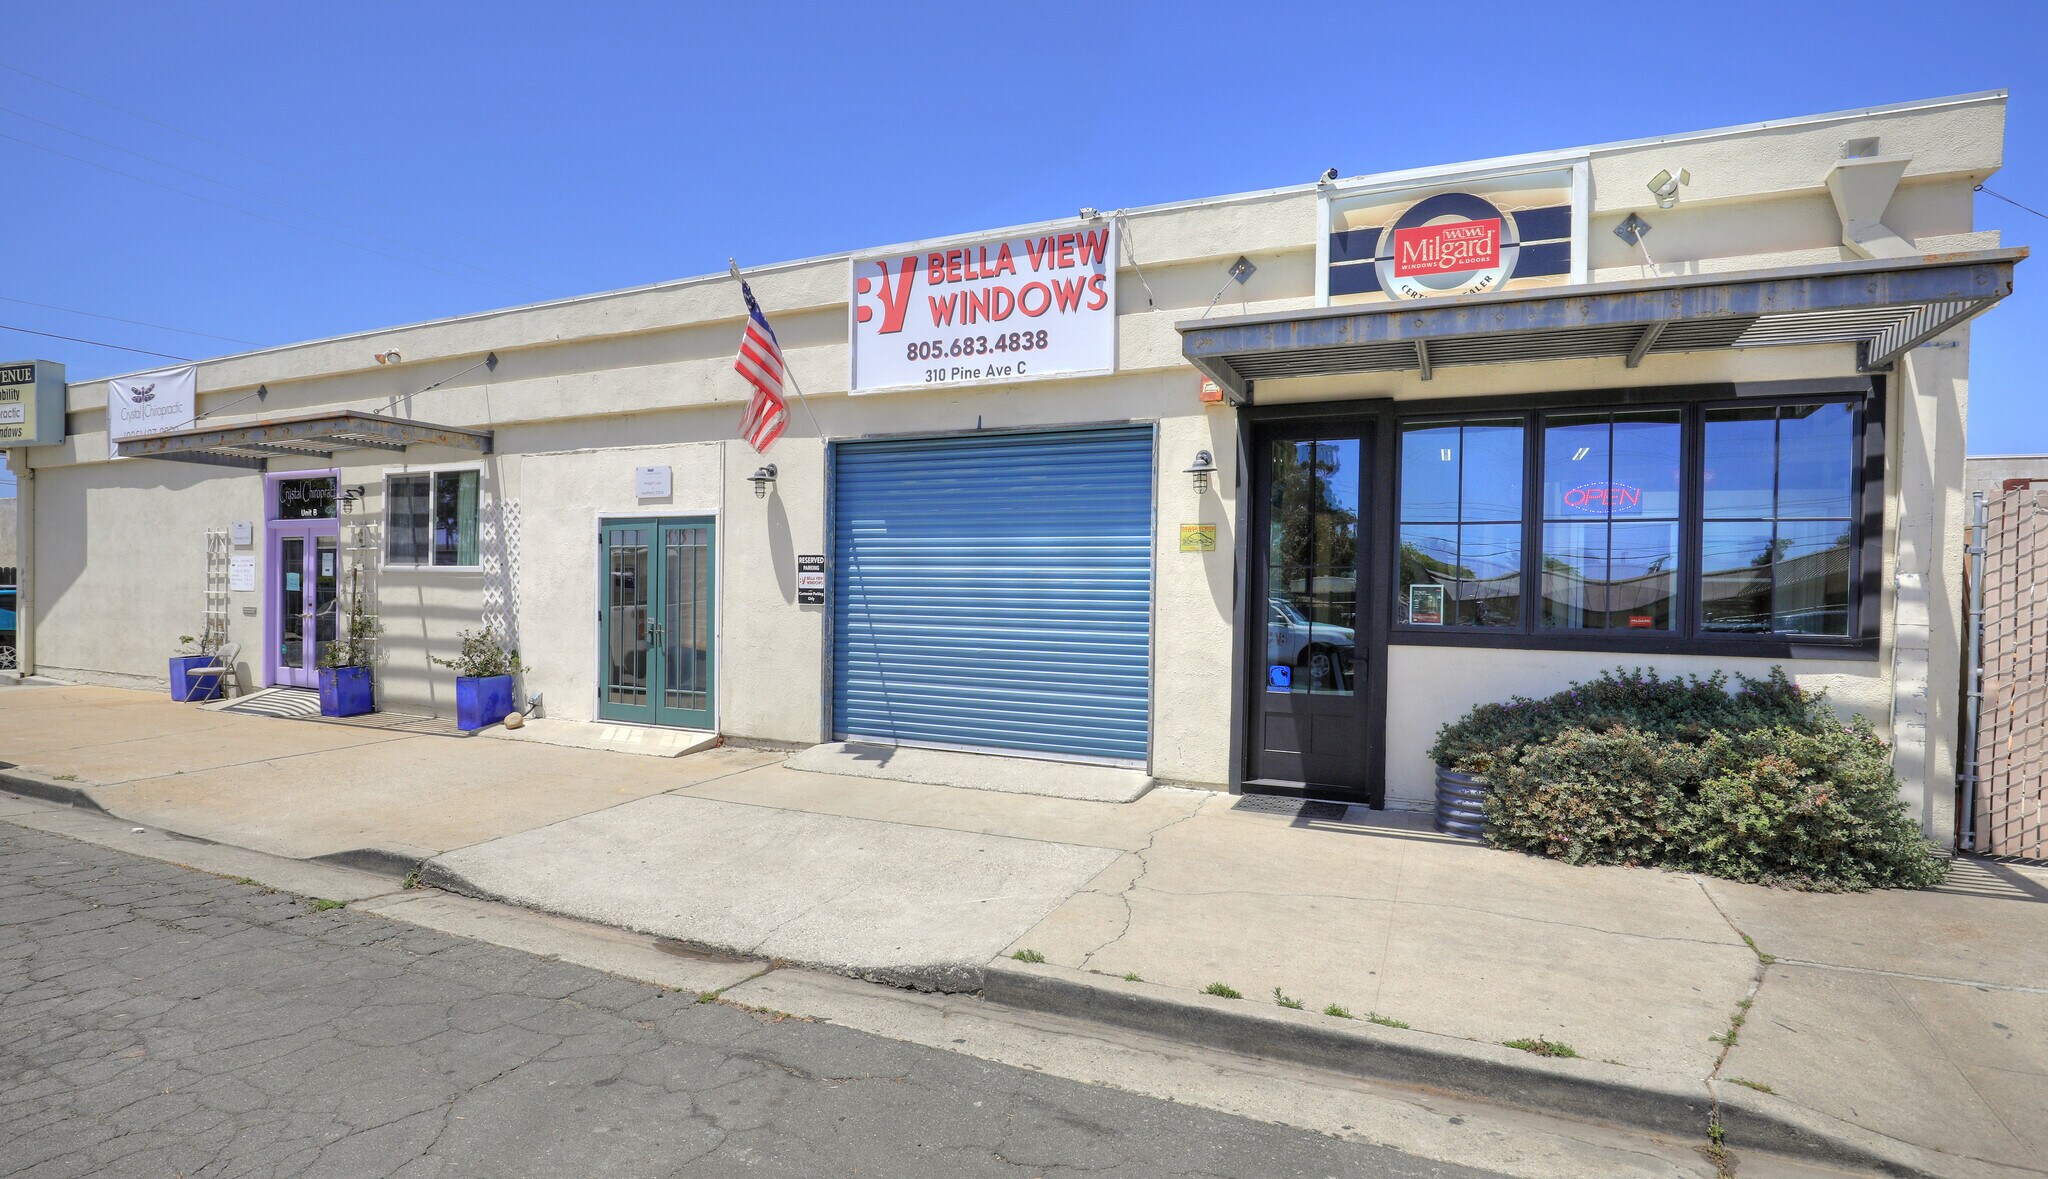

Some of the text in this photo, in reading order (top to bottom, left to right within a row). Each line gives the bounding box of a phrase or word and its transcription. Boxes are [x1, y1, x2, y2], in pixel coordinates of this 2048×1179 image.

[928, 228, 1109, 286] BELLA VIEW
[1402, 230, 1492, 269] Milgard
[1401, 261, 1438, 271] WINDOWS
[1465, 255, 1490, 264] DOORS
[928, 273, 1108, 328] WINDOWS
[907, 329, 1049, 361] 805.683.4838
[925, 360, 1027, 383] 310 Pine Ave C
[121, 401, 184, 423] Crystal Chiropractic
[280, 481, 302, 507] Crystal
[1564, 488, 1641, 506] OPEN
[301, 508, 318, 516] Unit B
[798, 556, 824, 564] RESERVED
